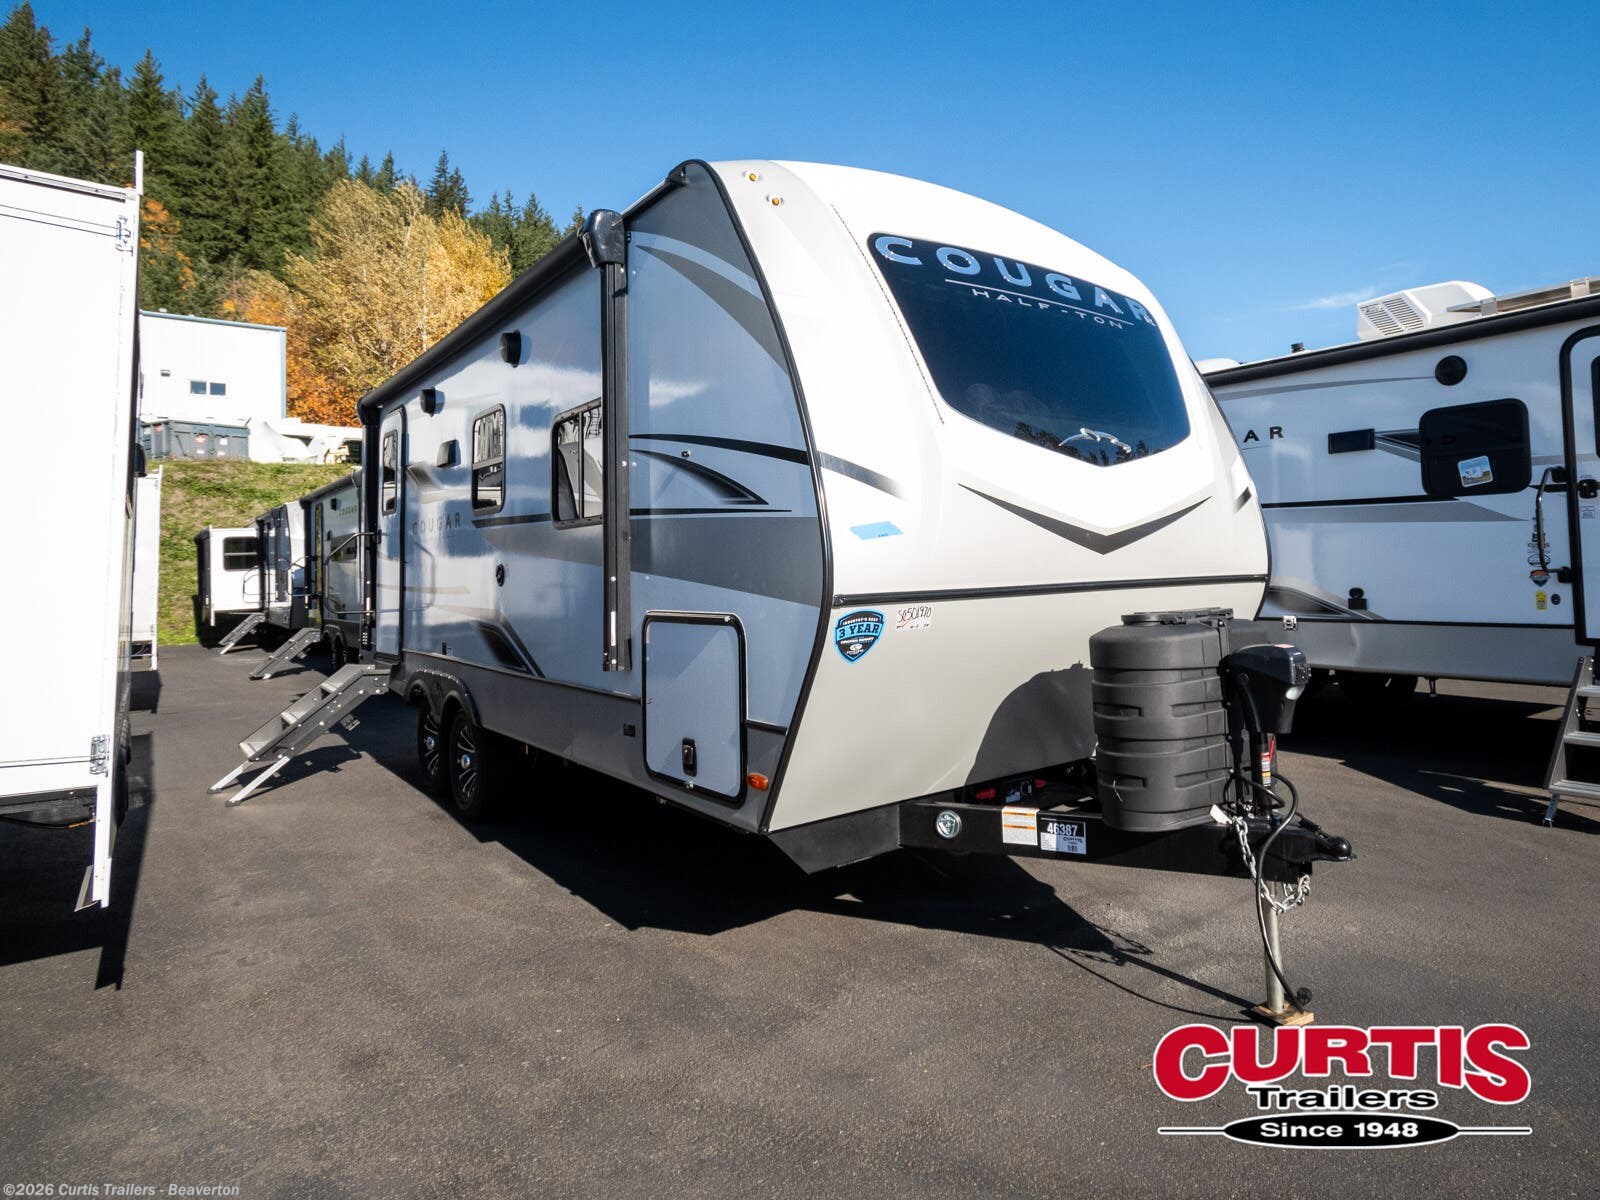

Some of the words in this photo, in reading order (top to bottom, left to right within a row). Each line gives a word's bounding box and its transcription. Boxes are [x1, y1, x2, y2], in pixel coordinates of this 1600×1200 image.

[875, 236, 1157, 327] COUGAR
[972, 288, 1123, 329] HALF-TON
[1243, 426, 1284, 443] AR
[412, 511, 461, 536] COUGAR
[839, 629, 845, 638] 3
[849, 623, 880, 635] YEAR
[1047, 822, 1078, 836] 46387
